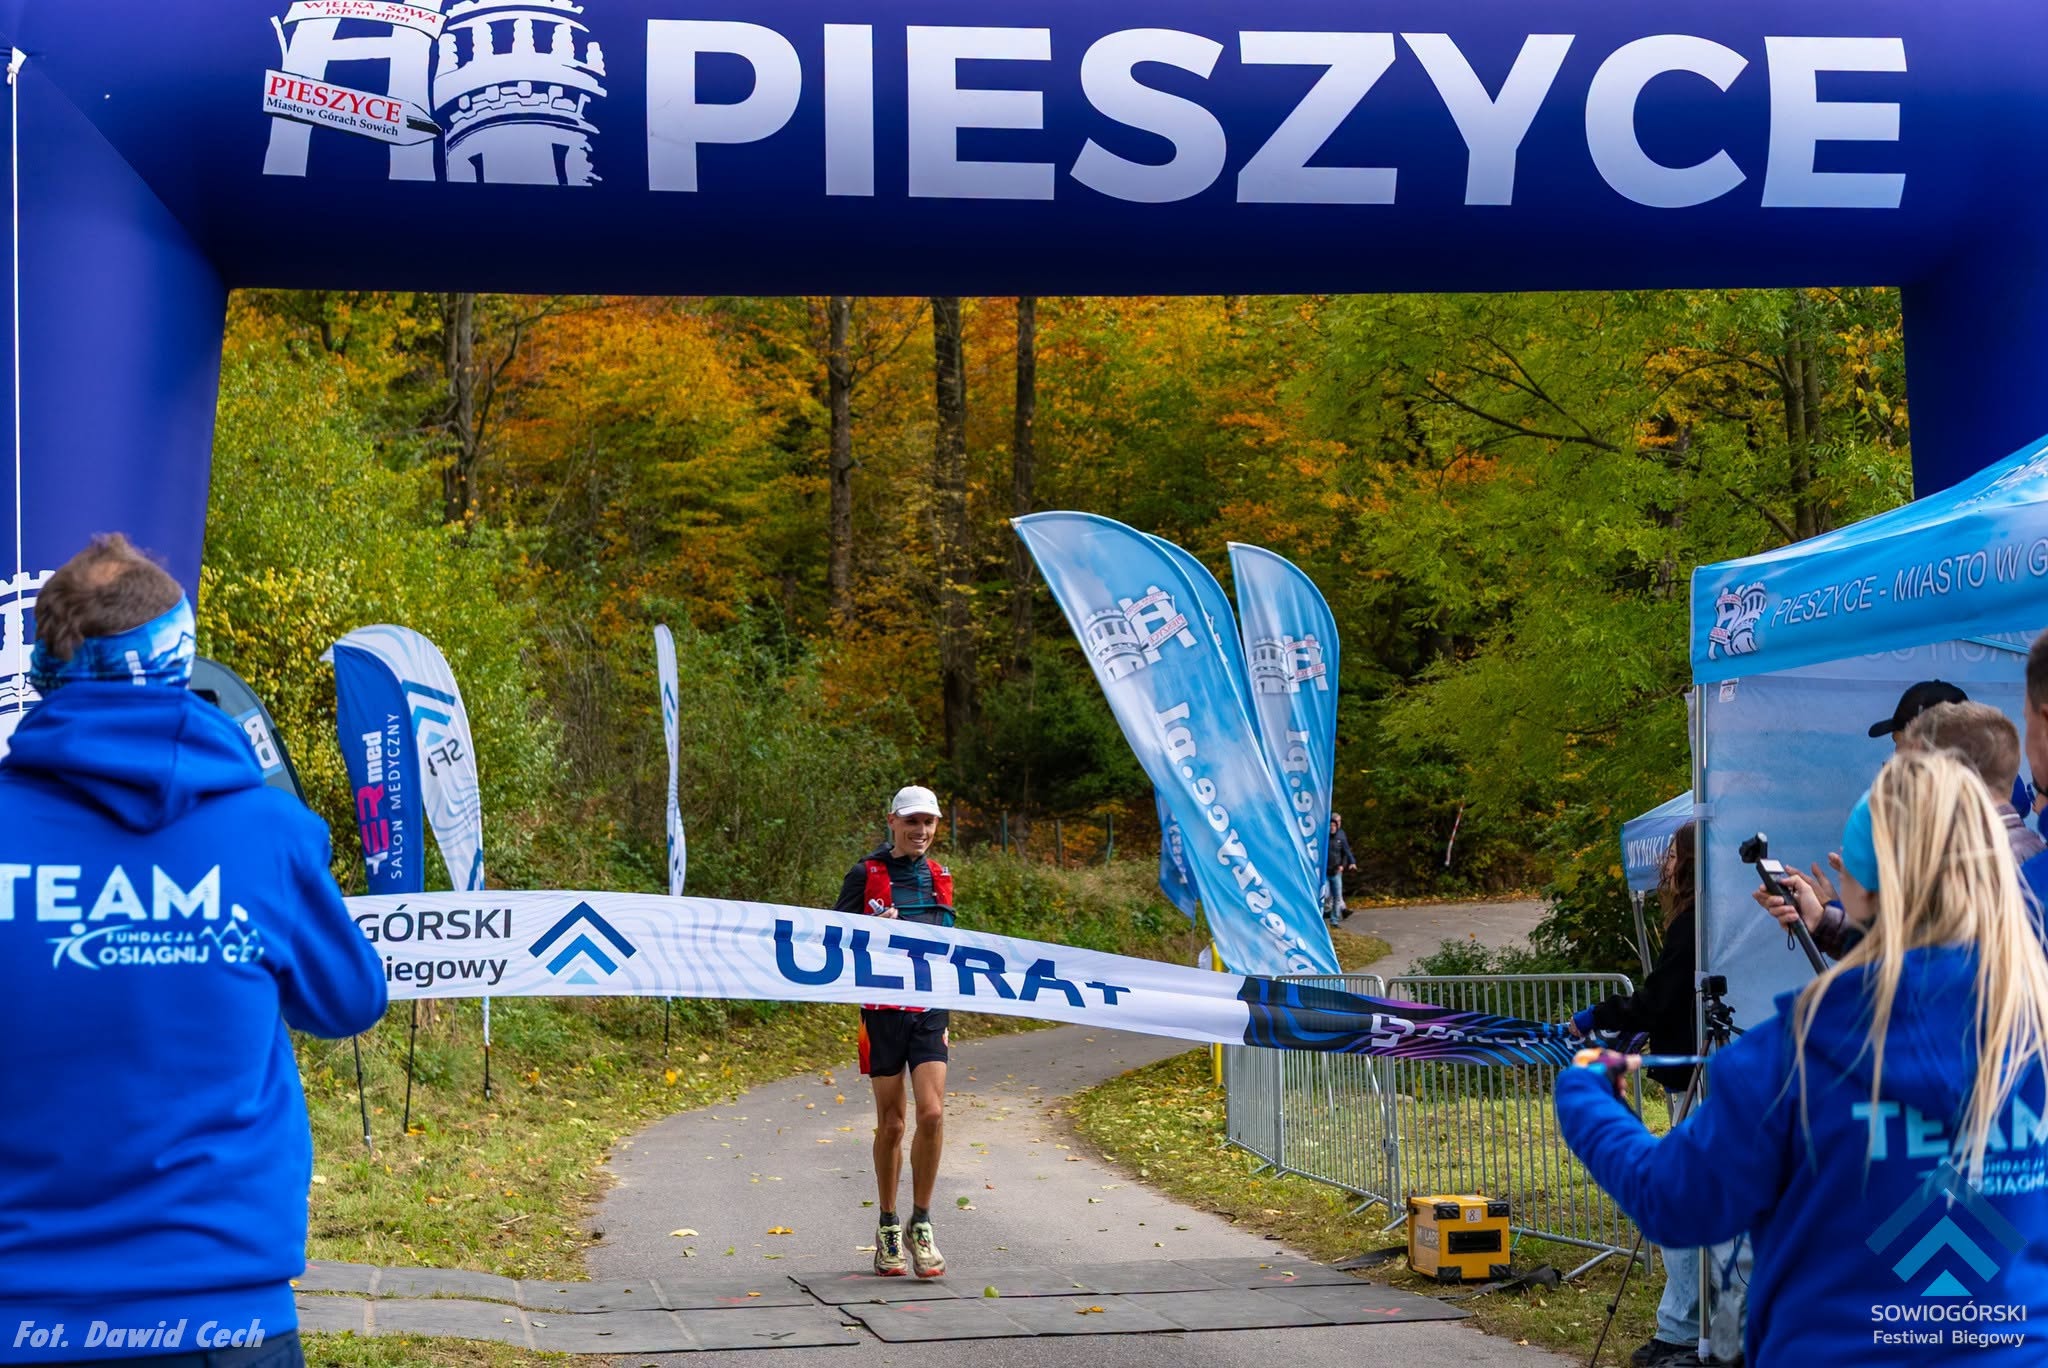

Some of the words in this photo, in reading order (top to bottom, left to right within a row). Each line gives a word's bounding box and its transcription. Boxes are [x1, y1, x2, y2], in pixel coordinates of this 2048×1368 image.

[386, 4, 437, 24] SOWA
[266, 96, 303, 114] Miasto
[306, 107, 316, 116] w
[318, 109, 357, 127] Górach
[359, 119, 398, 137] Sowich
[267, 75, 402, 124] PIESZYCE
[646, 17, 1908, 210] PIESZYCE
[1771, 575, 1878, 628] PIESZYCE
[1893, 551, 1988, 602] MIASTO
[1996, 543, 2023, 583] W
[387, 713, 402, 810] MEDYCZNY
[391, 819, 403, 880] SALON
[1627, 835, 1665, 869] WYNIKI
[0, 863, 220, 921] TEAM
[98, 944, 210, 966] OSIĄGNIJ
[106, 931, 195, 944] FUNDACJA
[381, 956, 508, 988] iegowy
